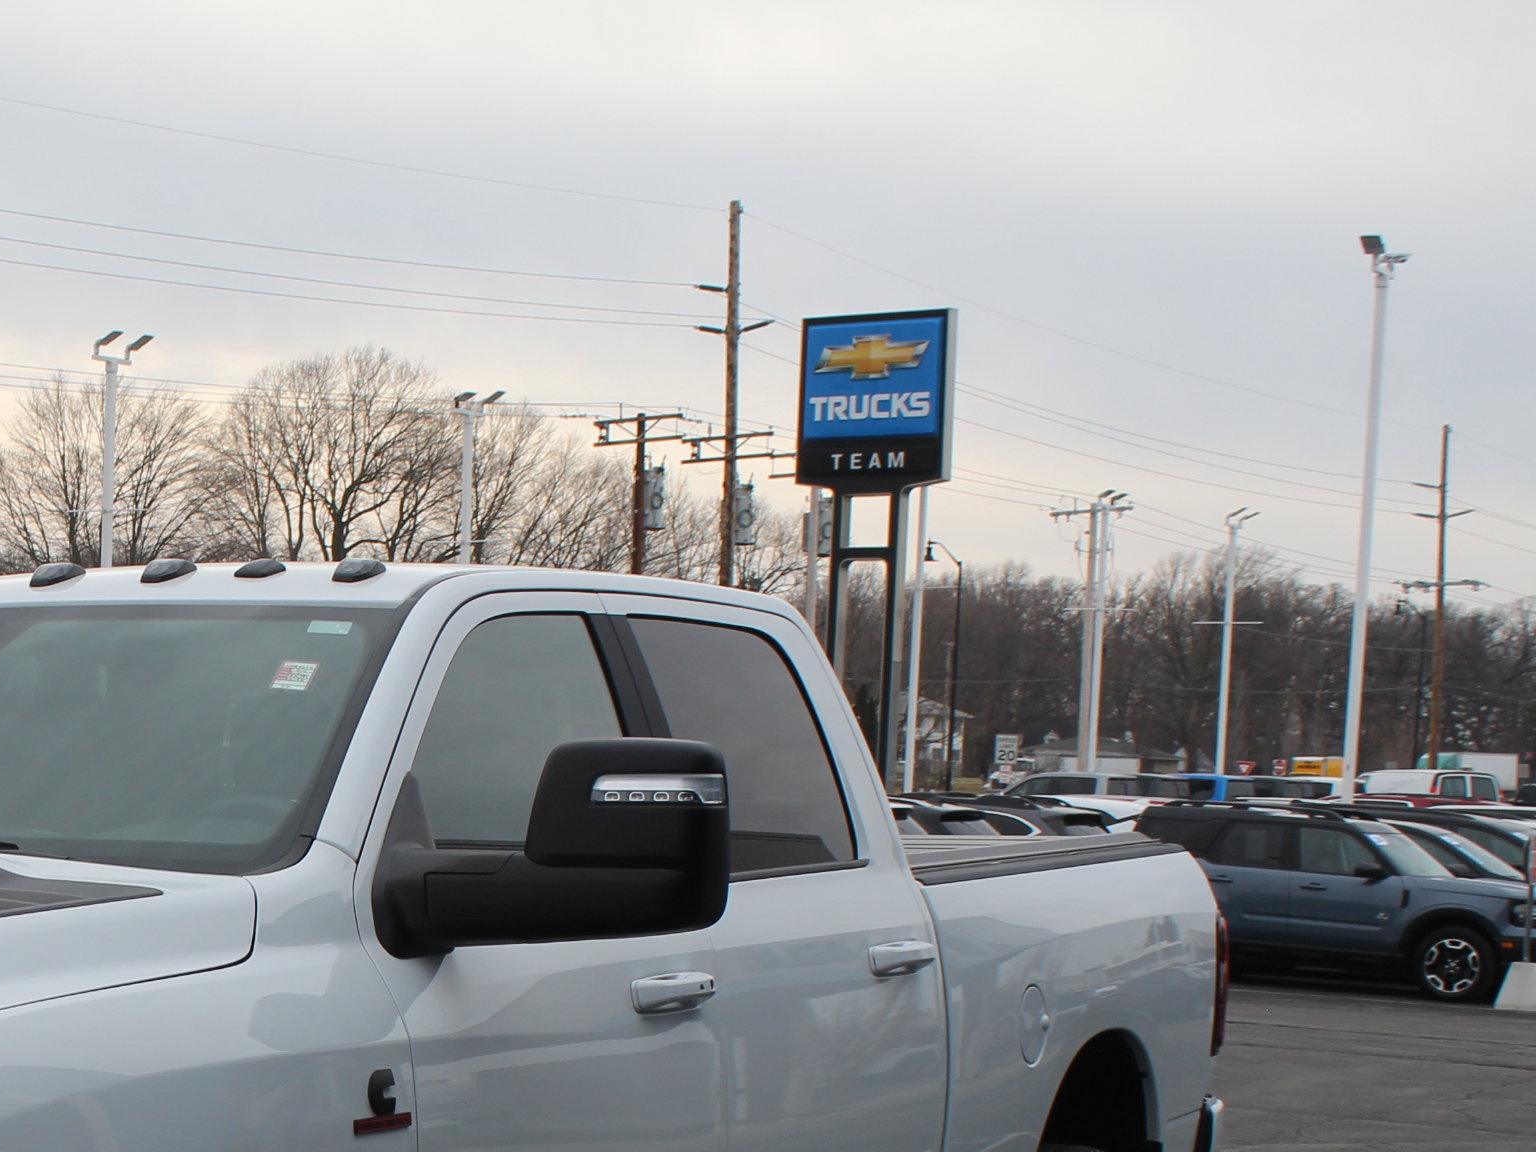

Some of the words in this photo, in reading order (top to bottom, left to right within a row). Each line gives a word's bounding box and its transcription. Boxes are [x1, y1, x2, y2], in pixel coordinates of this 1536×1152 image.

[809, 391, 931, 422] TRUCKS
[831, 451, 905, 470] TEAM
[998, 749, 1015, 761] 20
